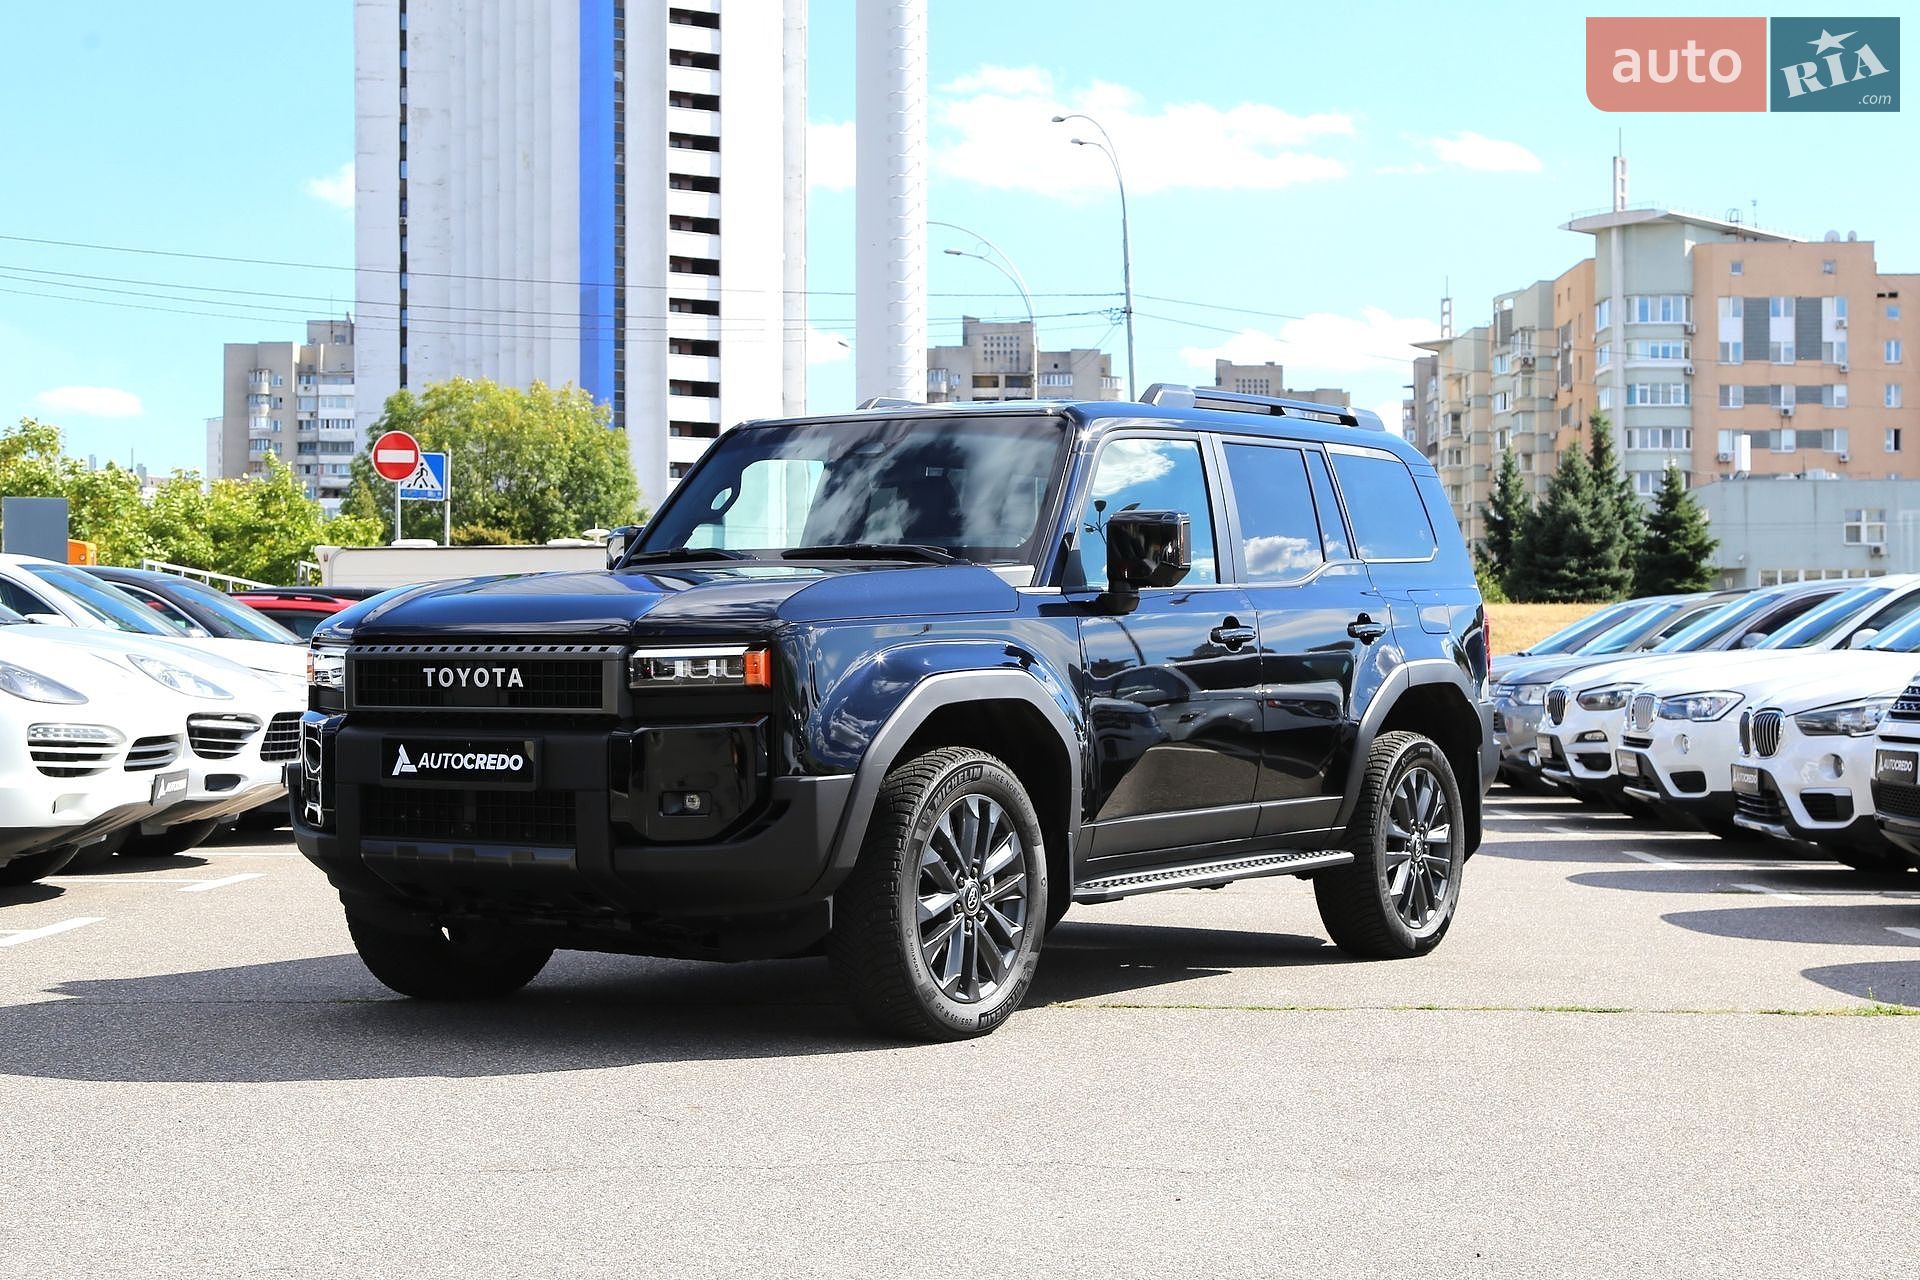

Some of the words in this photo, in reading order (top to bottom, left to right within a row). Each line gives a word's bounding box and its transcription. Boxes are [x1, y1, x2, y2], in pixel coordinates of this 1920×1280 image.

[423, 667, 523, 688] TOYOTA
[418, 752, 523, 771] AUTOCREDO
[933, 767, 981, 809] MICHELIN
